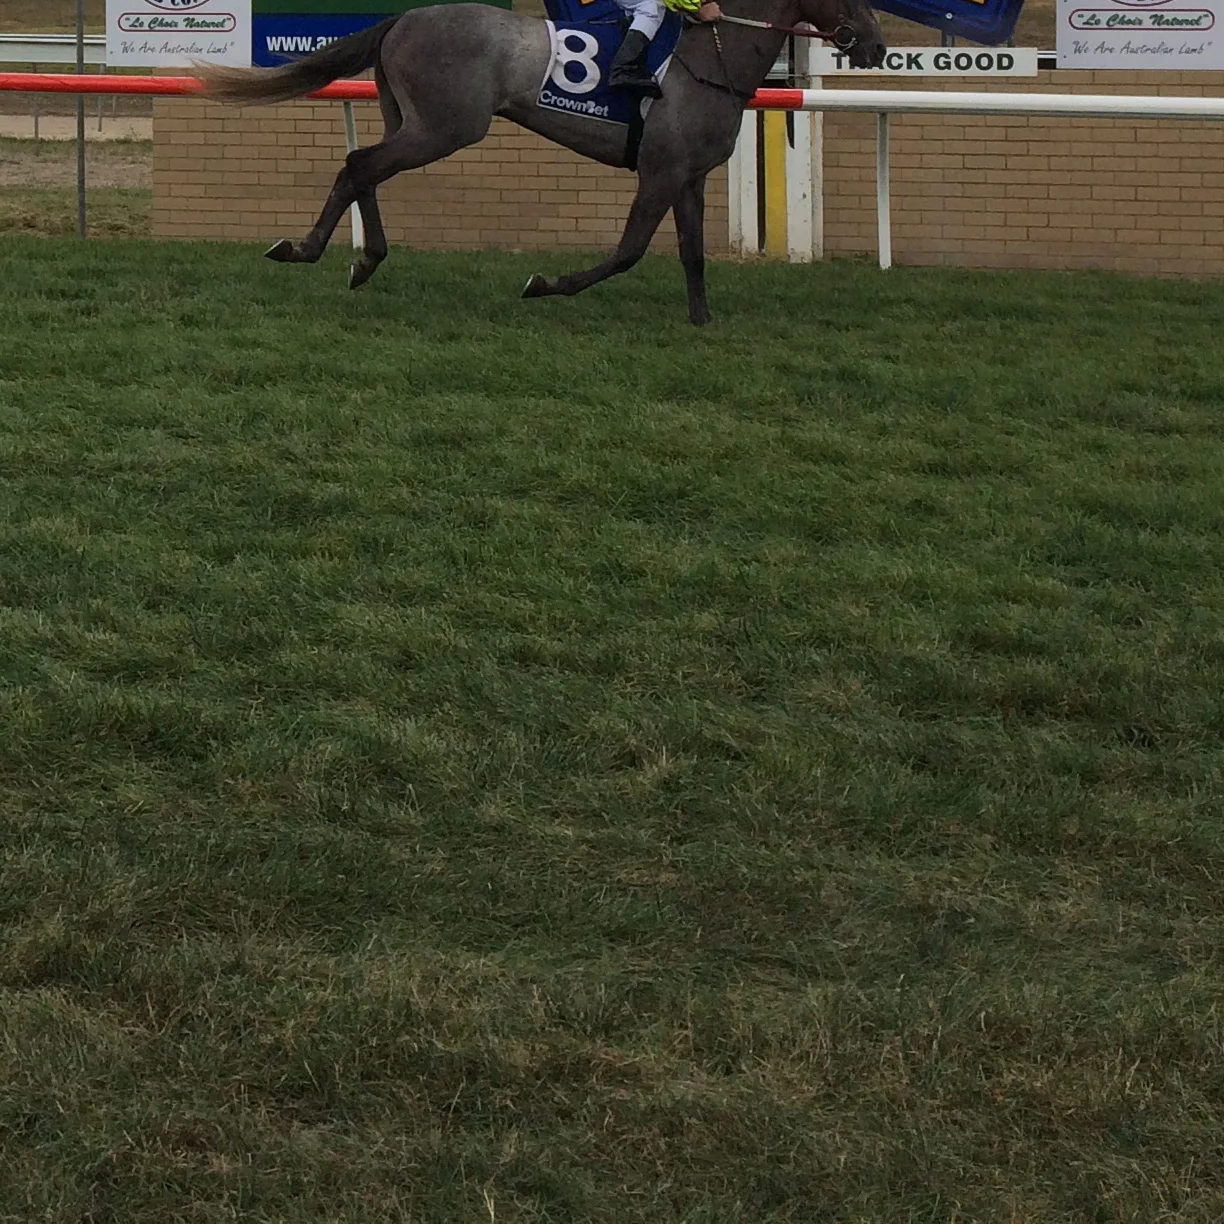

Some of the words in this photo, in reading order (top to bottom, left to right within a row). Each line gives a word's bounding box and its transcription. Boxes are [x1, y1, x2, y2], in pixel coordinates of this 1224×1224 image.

[147, 16, 178, 30] Choix
[1106, 13, 1143, 28] Choix
[138, 41, 156, 54] Are
[159, 41, 203, 54] Australian
[1093, 40, 1115, 54] Are
[1119, 40, 1174, 55] Australian
[551, 28, 601, 94] 8
[933, 52, 1015, 71] GOOD
[540, 90, 610, 117] CrownBet
